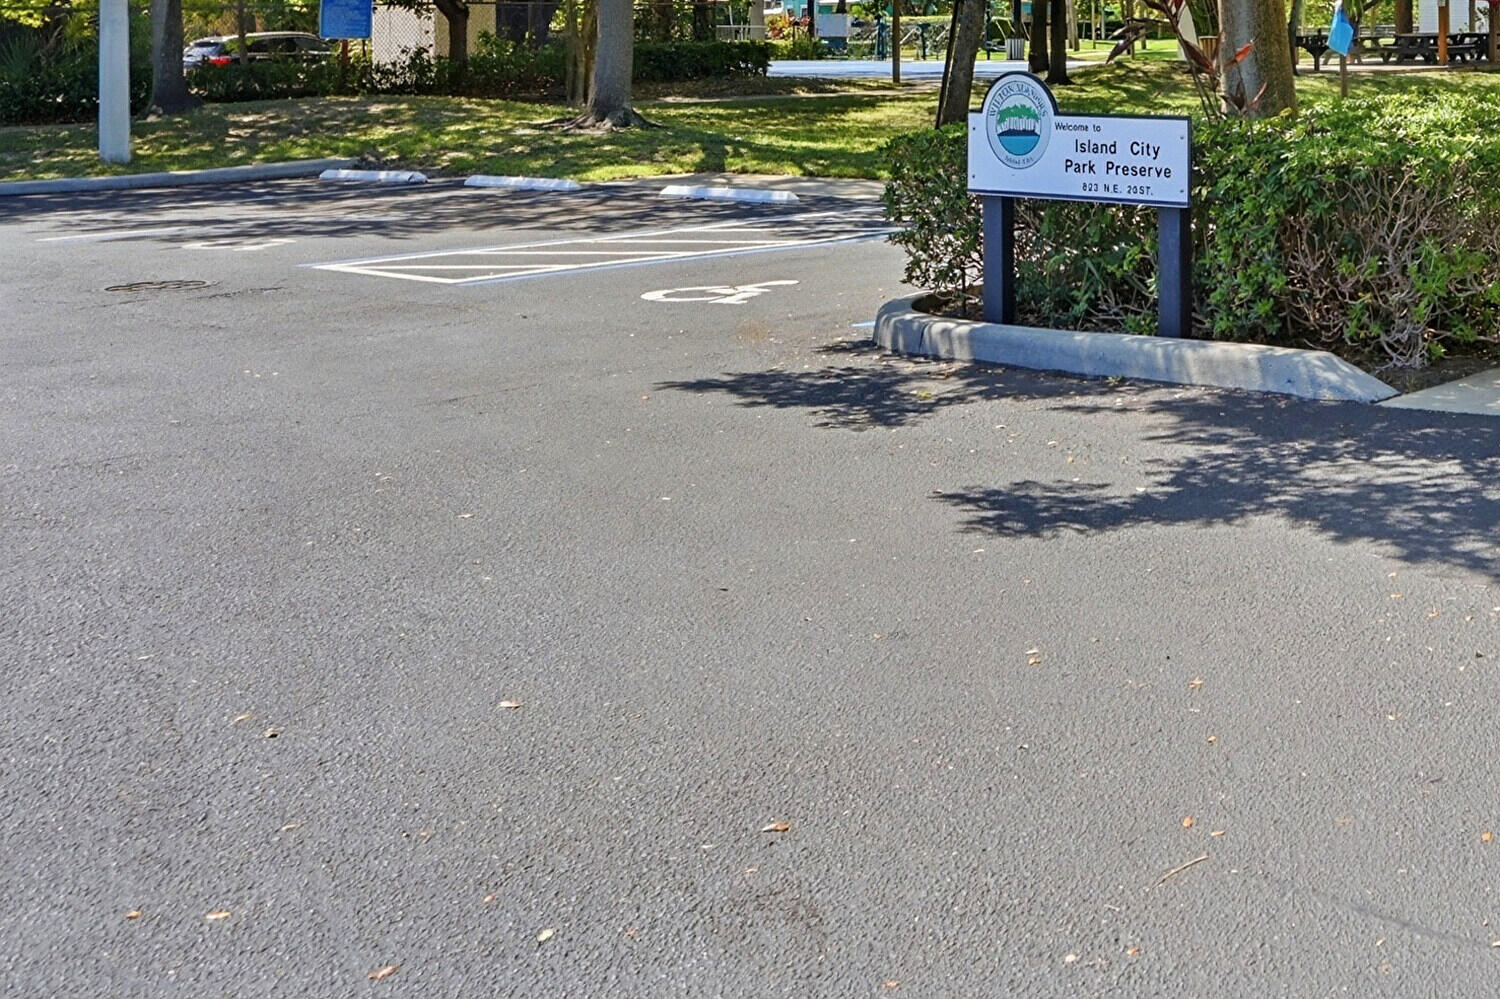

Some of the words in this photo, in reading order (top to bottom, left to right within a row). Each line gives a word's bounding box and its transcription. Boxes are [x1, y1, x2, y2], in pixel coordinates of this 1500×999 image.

[1054, 122, 1089, 132] Welcome
[1092, 124, 1102, 132] to
[1075, 138, 1117, 155] Island
[1129, 141, 1161, 161] City
[1064, 158, 1097, 175] Park
[1105, 160, 1173, 179] Preserve
[1103, 183, 1122, 194] N.E.
